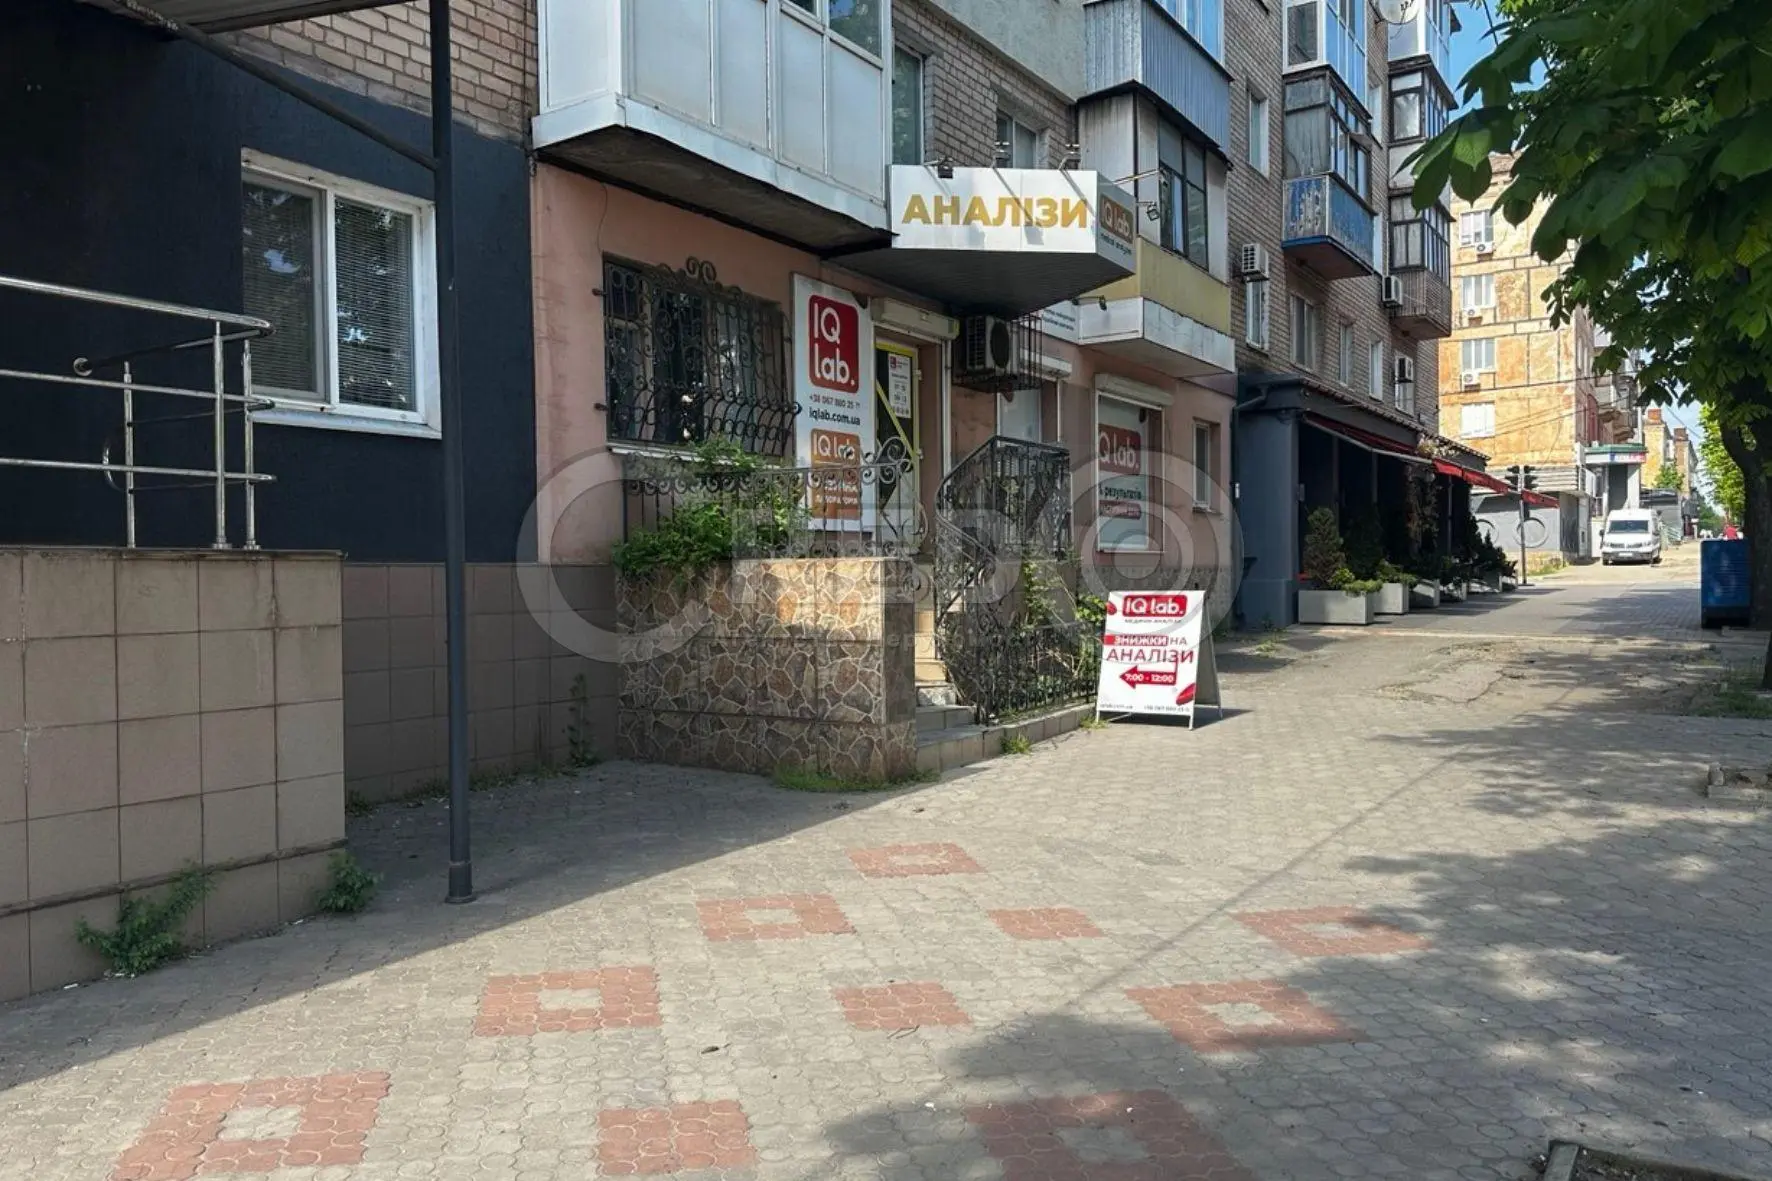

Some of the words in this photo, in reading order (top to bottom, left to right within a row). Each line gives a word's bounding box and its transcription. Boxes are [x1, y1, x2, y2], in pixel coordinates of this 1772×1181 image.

[901, 194, 1087, 229] АНАЛІЗИ
[813, 303, 840, 344] IQ
[814, 343, 855, 386] lab.
[813, 432, 831, 457] IQ
[1126, 598, 1147, 614] IQ
[1151, 598, 1183, 615] lab.
[1115, 635, 1167, 646] ЗНИЖКИ
[1170, 636, 1188, 645] НА
[1106, 648, 1194, 664] АНАЛІЗИ
[1125, 673, 1144, 682] 7:00
[1151, 674, 1175, 683] 12:00
